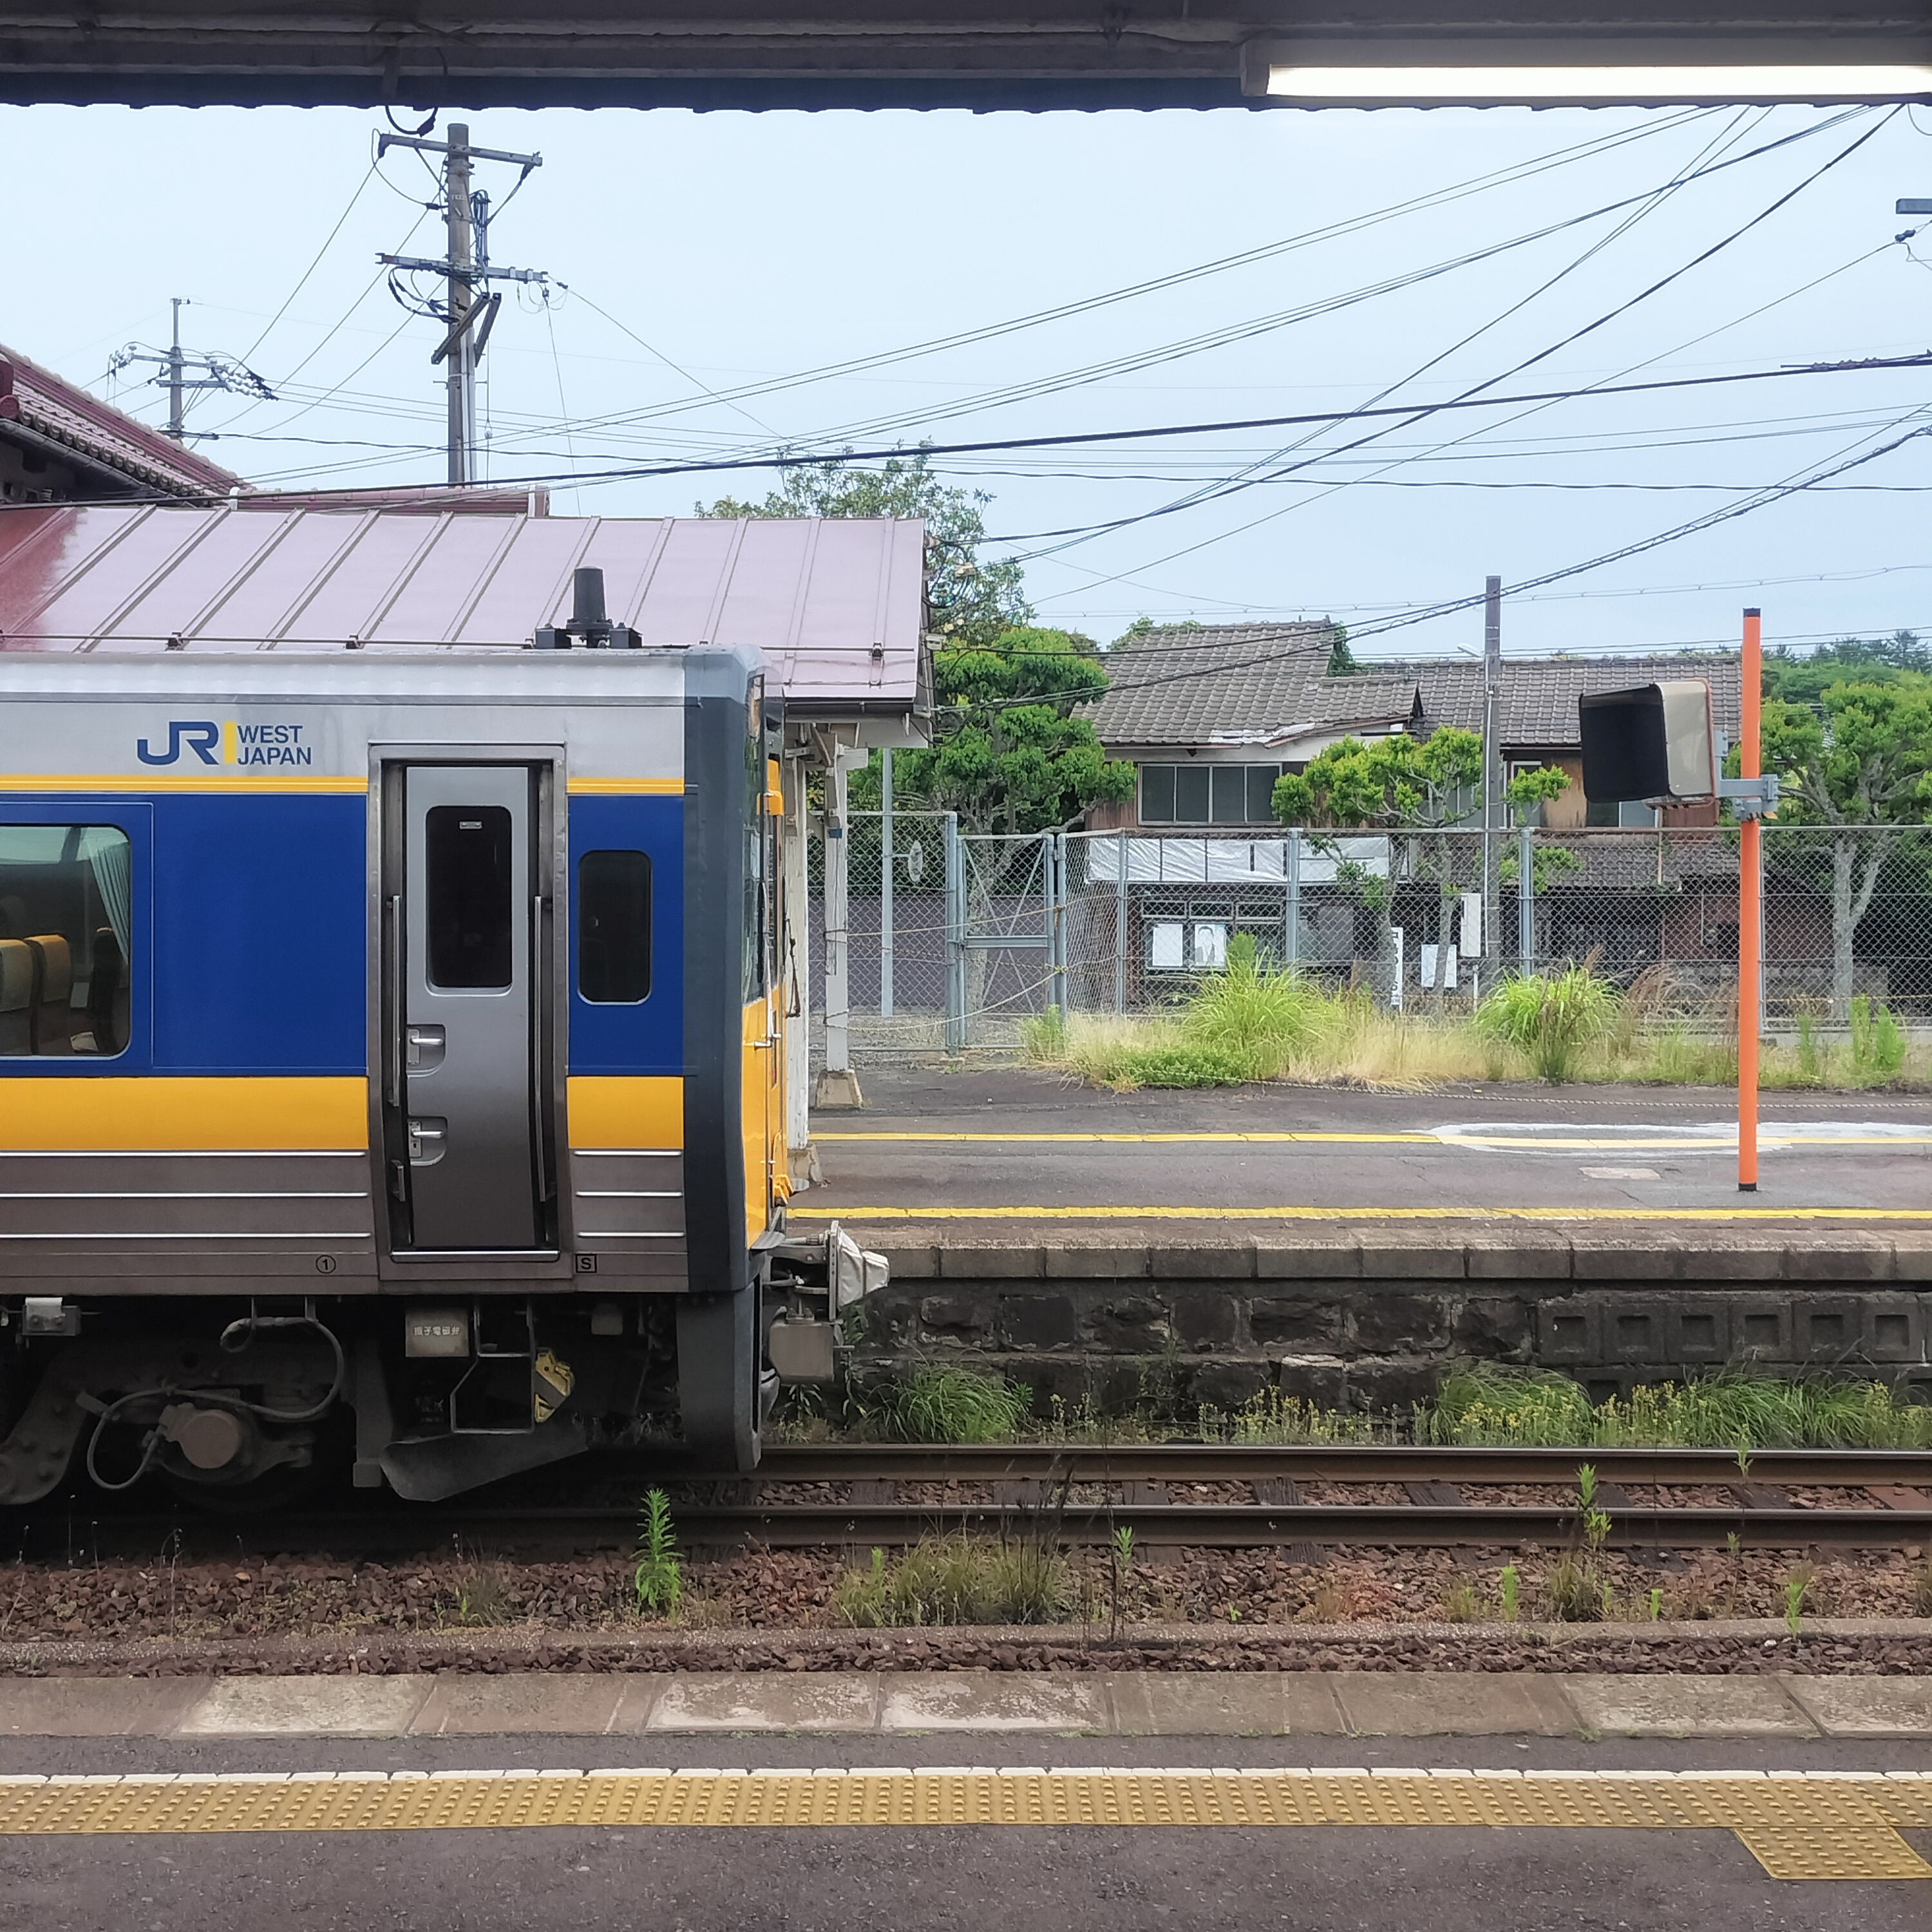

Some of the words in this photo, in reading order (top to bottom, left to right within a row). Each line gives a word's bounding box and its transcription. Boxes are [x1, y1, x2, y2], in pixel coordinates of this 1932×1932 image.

[137, 721, 219, 765] JR
[238, 725, 303, 743] WEST
[238, 746, 311, 764] JAPAN
